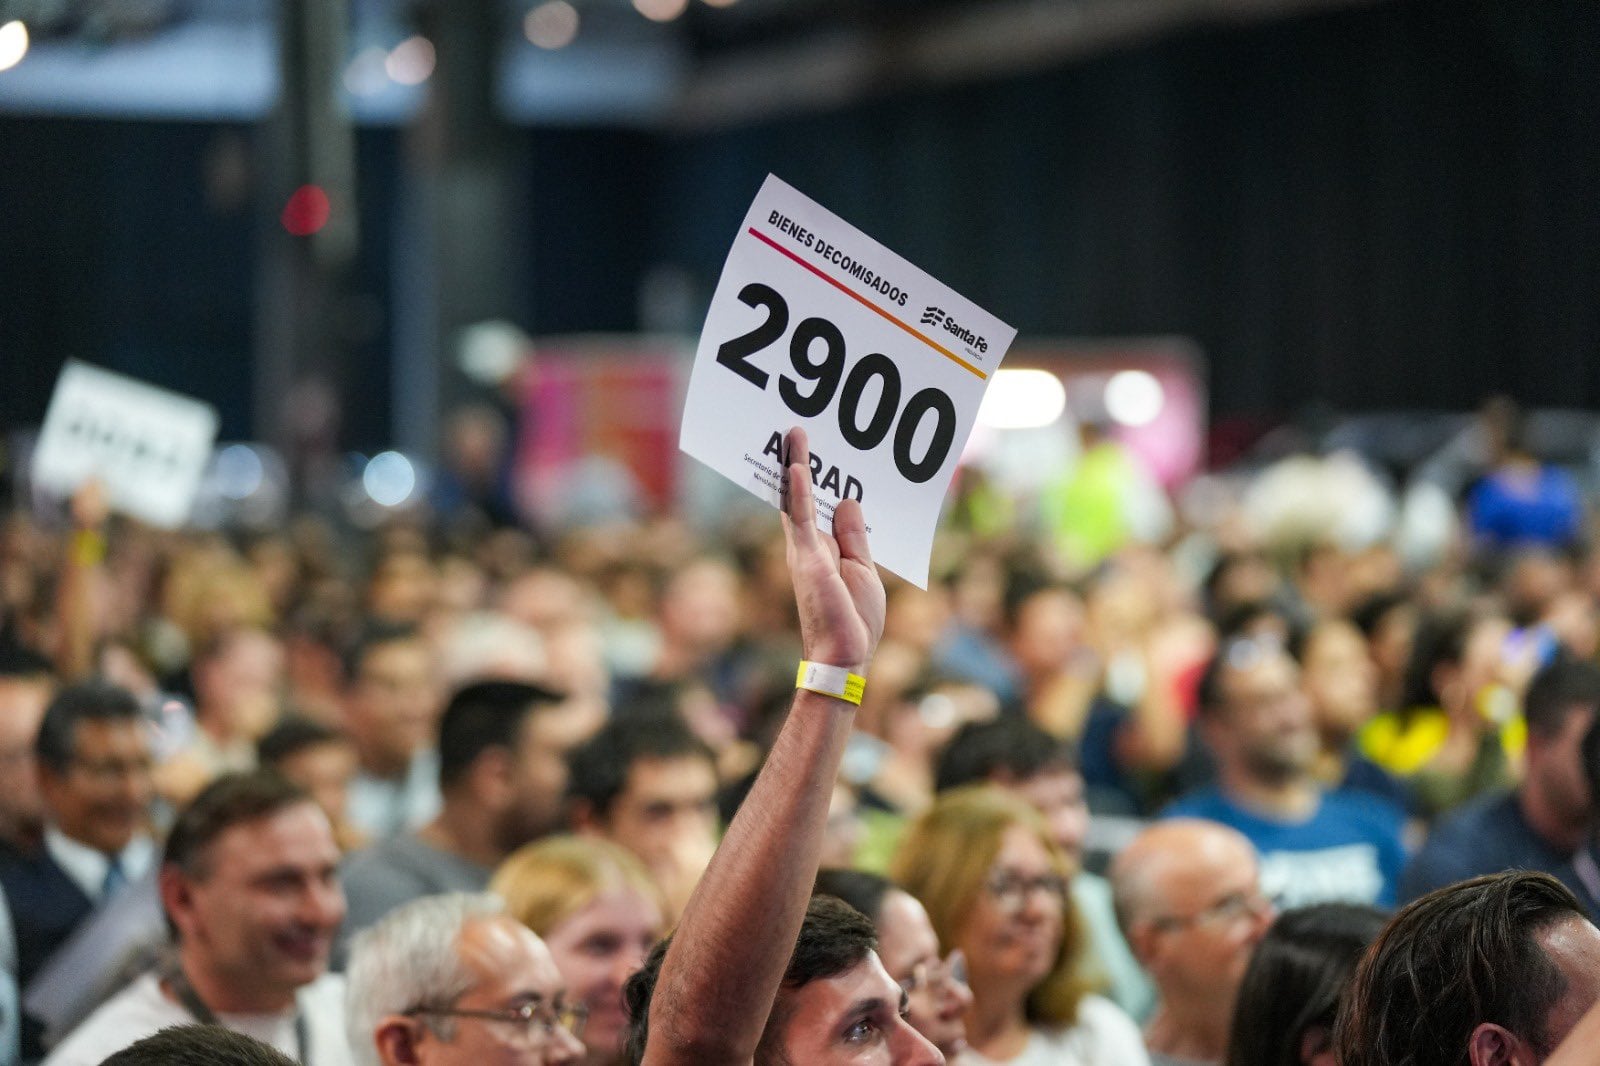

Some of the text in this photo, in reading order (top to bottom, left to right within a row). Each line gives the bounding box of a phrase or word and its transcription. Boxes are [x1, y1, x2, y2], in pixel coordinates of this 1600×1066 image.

[768, 210, 909, 307] BIENES DECOMISADOS
[943, 317, 988, 353] Santa Fe
[716, 282, 957, 484] 2900
[762, 430, 863, 504] ARAD
